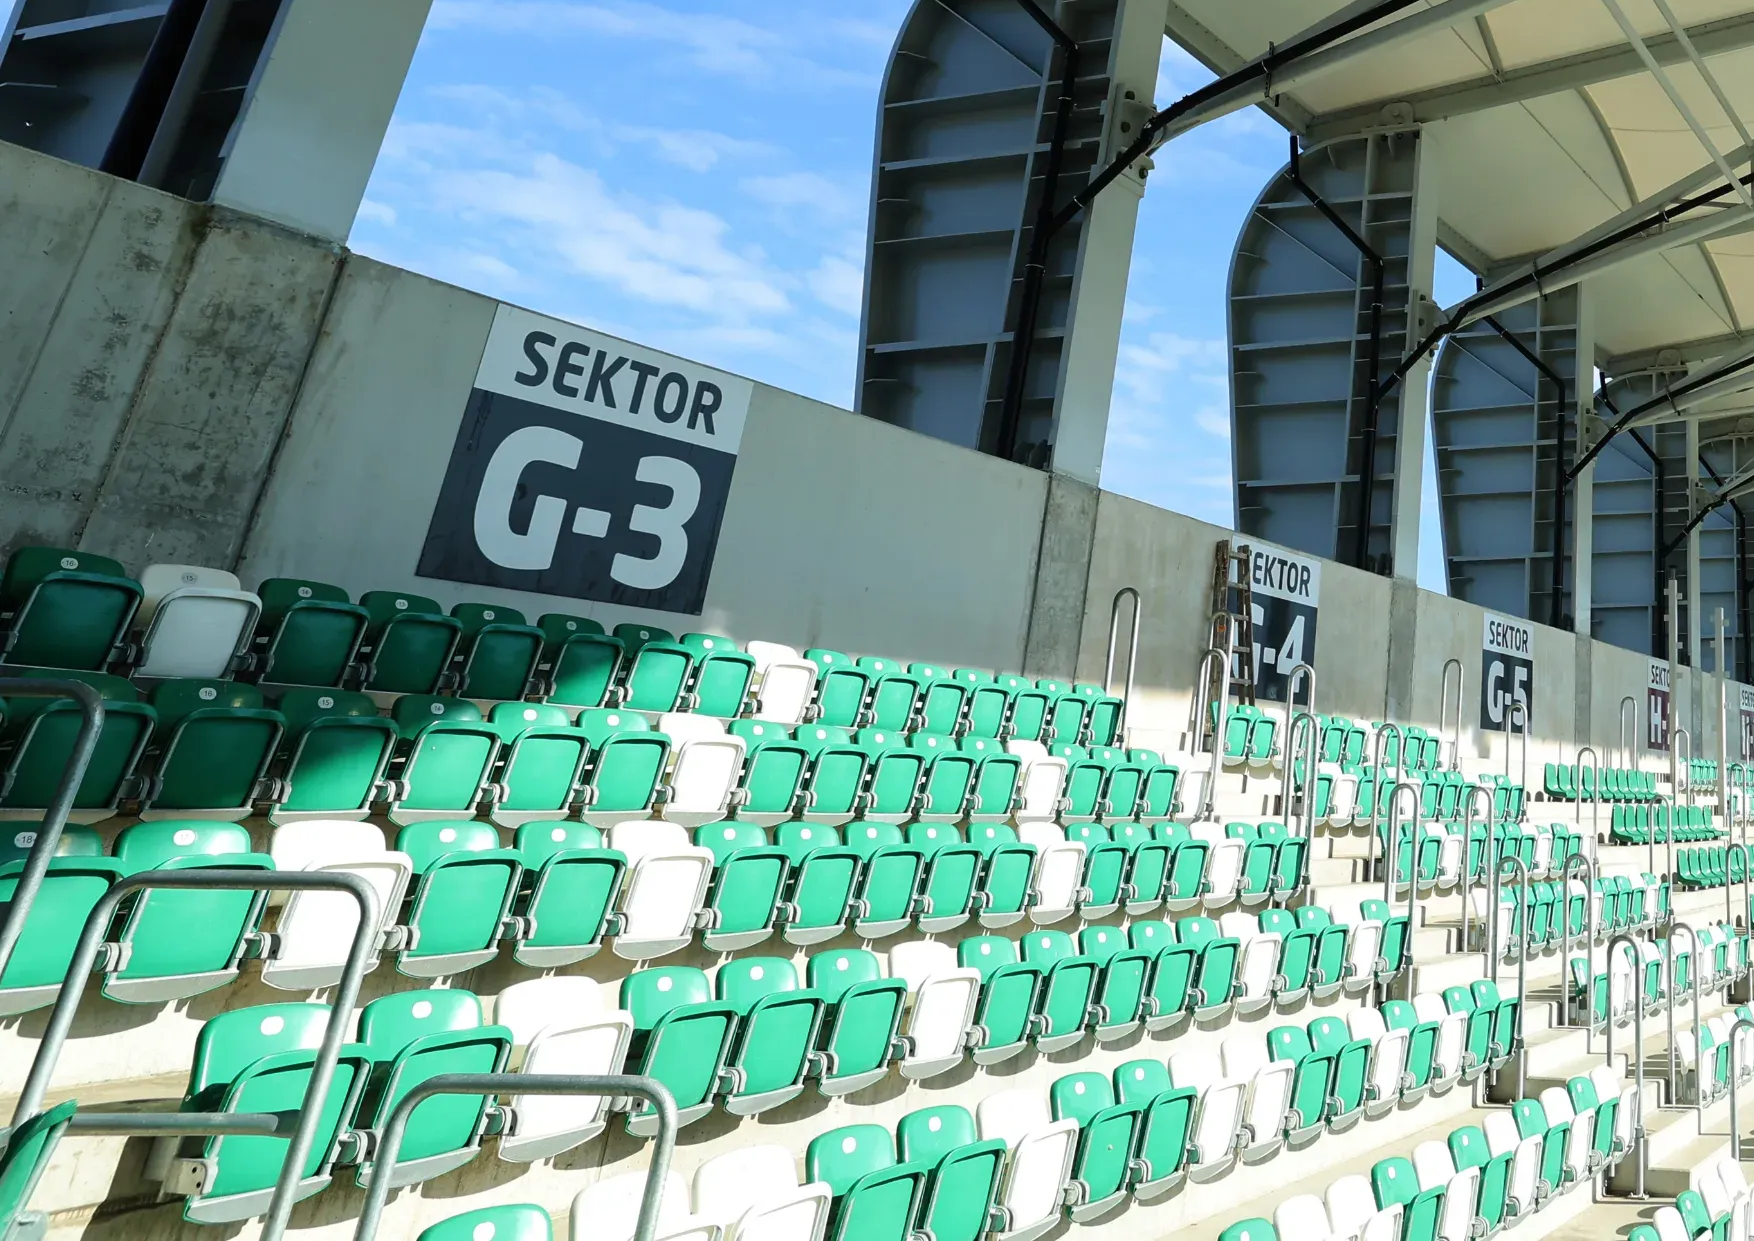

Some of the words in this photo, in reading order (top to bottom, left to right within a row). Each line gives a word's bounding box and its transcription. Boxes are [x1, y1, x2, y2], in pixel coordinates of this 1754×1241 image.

[514, 330, 722, 435] SEKTOR
[473, 425, 701, 590] G-3
[1249, 550, 1311, 598] EKTOR
[1489, 620, 1529, 654] SEKTOR
[1487, 660, 1528, 726] G-5
[1651, 664, 1670, 688] SEKTO
[1651, 695, 1670, 745] H-
[22, 835, 33, 843] 18
